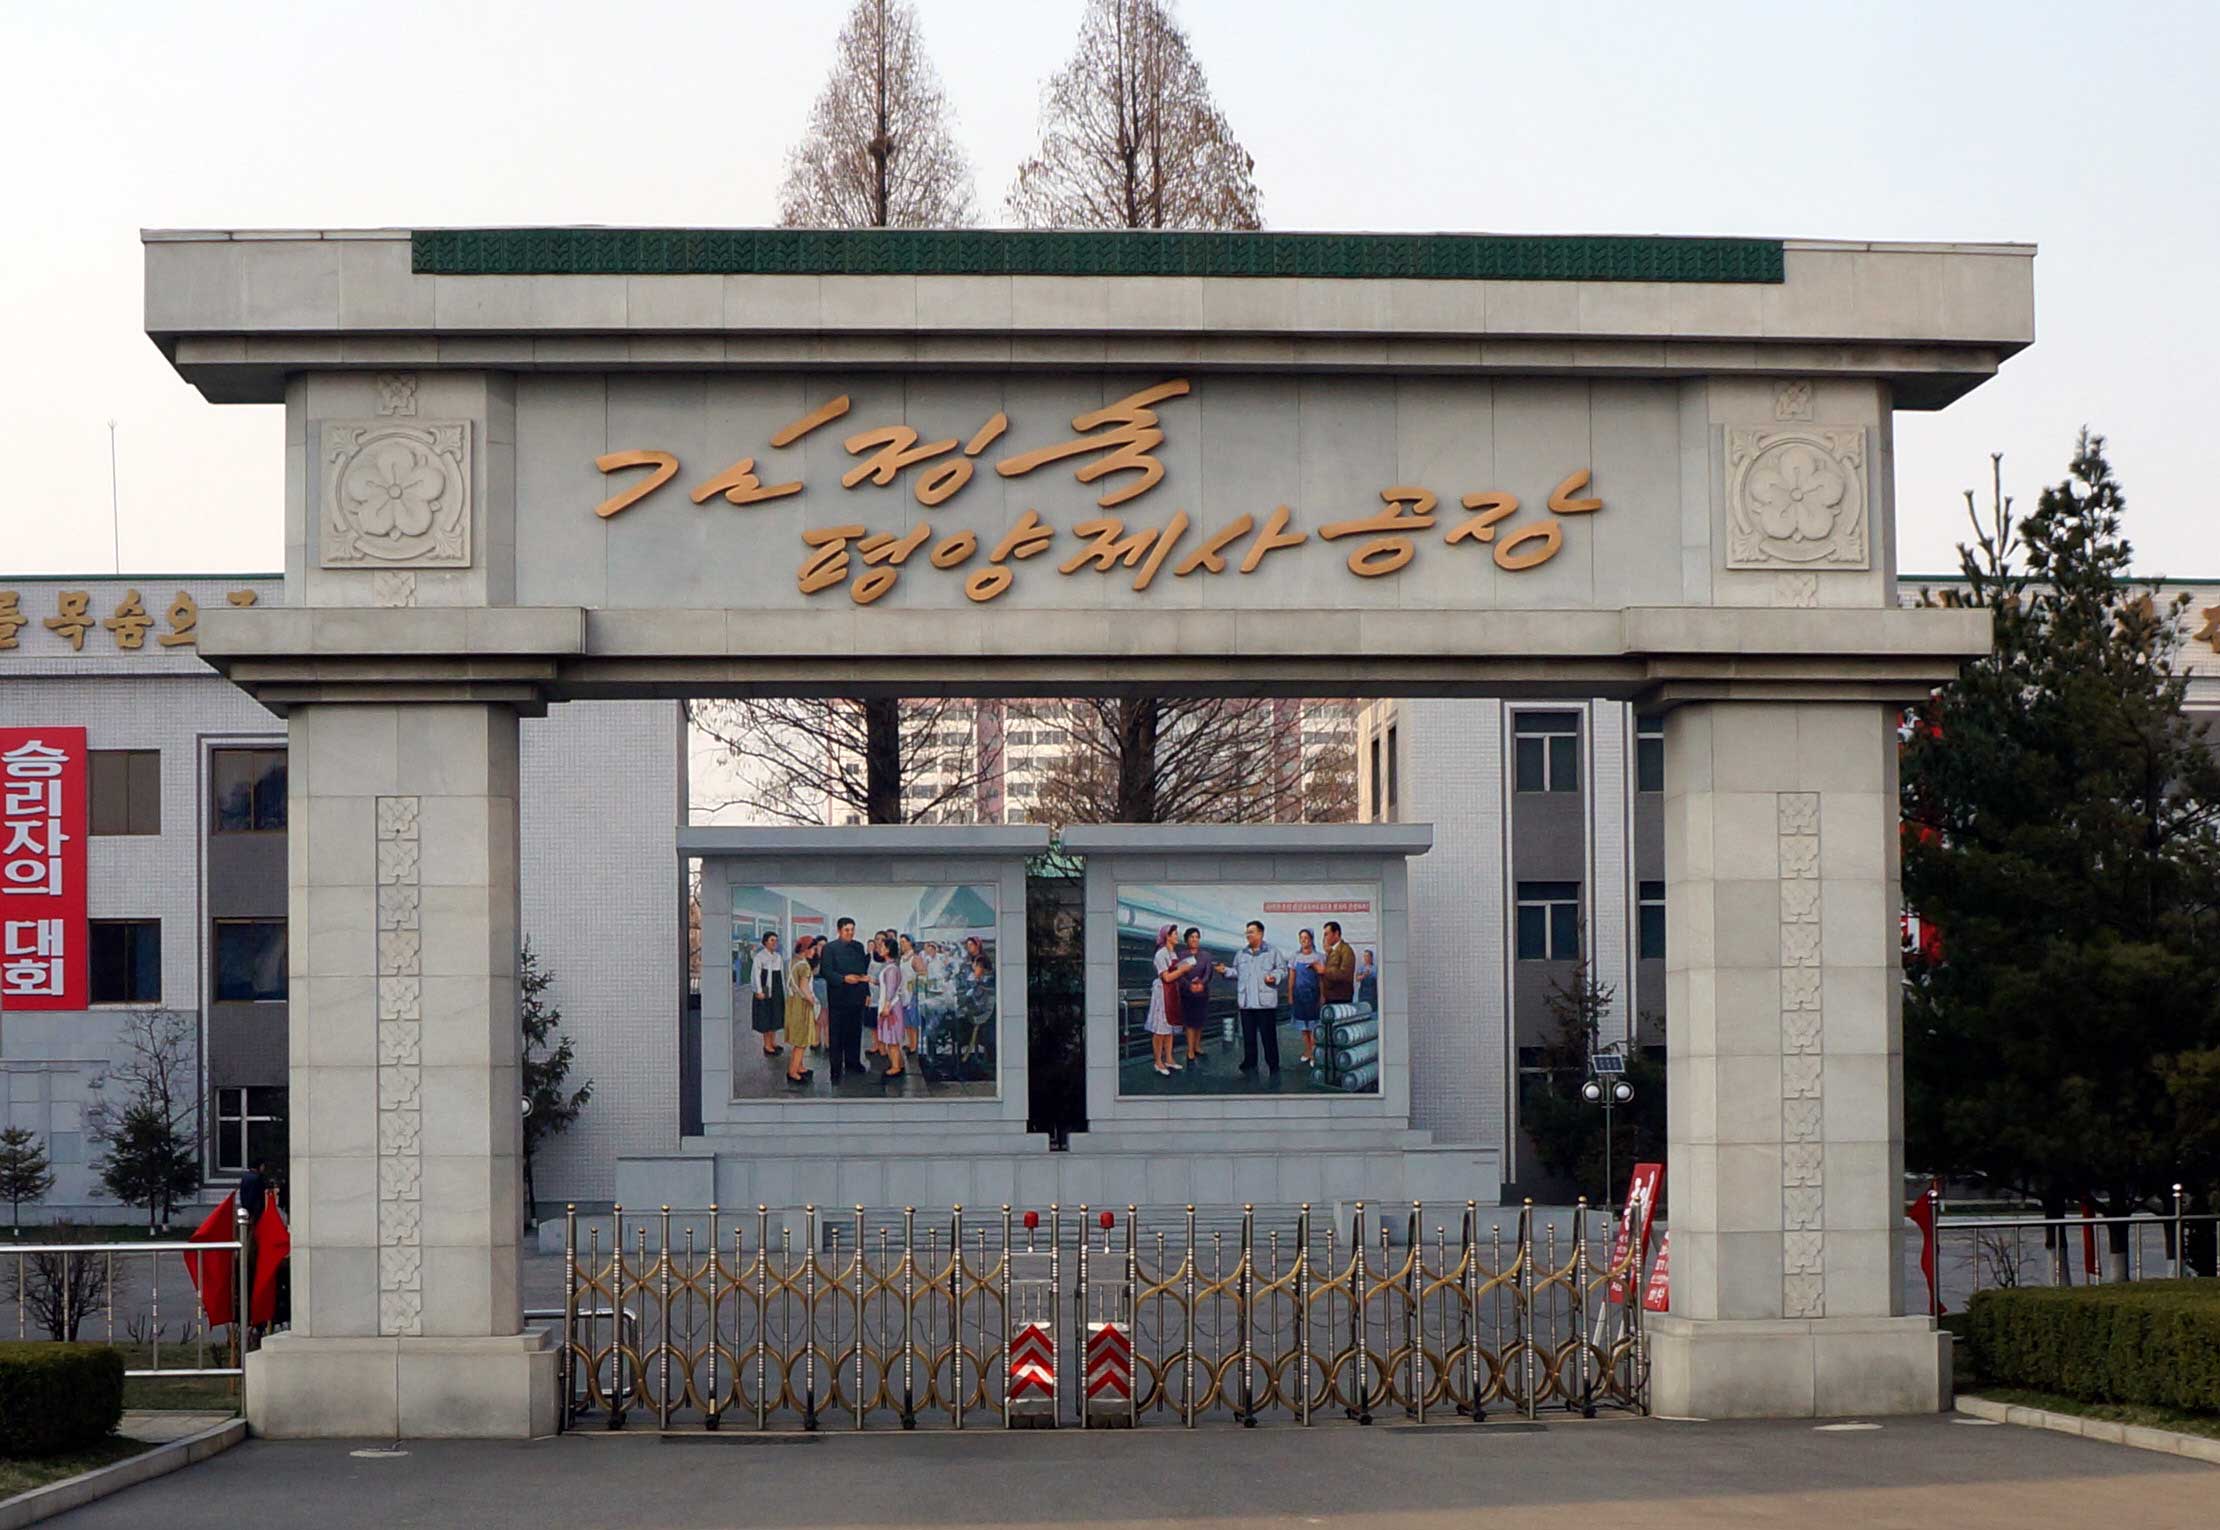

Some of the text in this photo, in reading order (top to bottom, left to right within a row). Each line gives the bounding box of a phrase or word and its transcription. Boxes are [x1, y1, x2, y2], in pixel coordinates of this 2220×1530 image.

[595, 382, 1191, 519] 김정숙
[1, 740, 70, 997] 승리자의 대회
